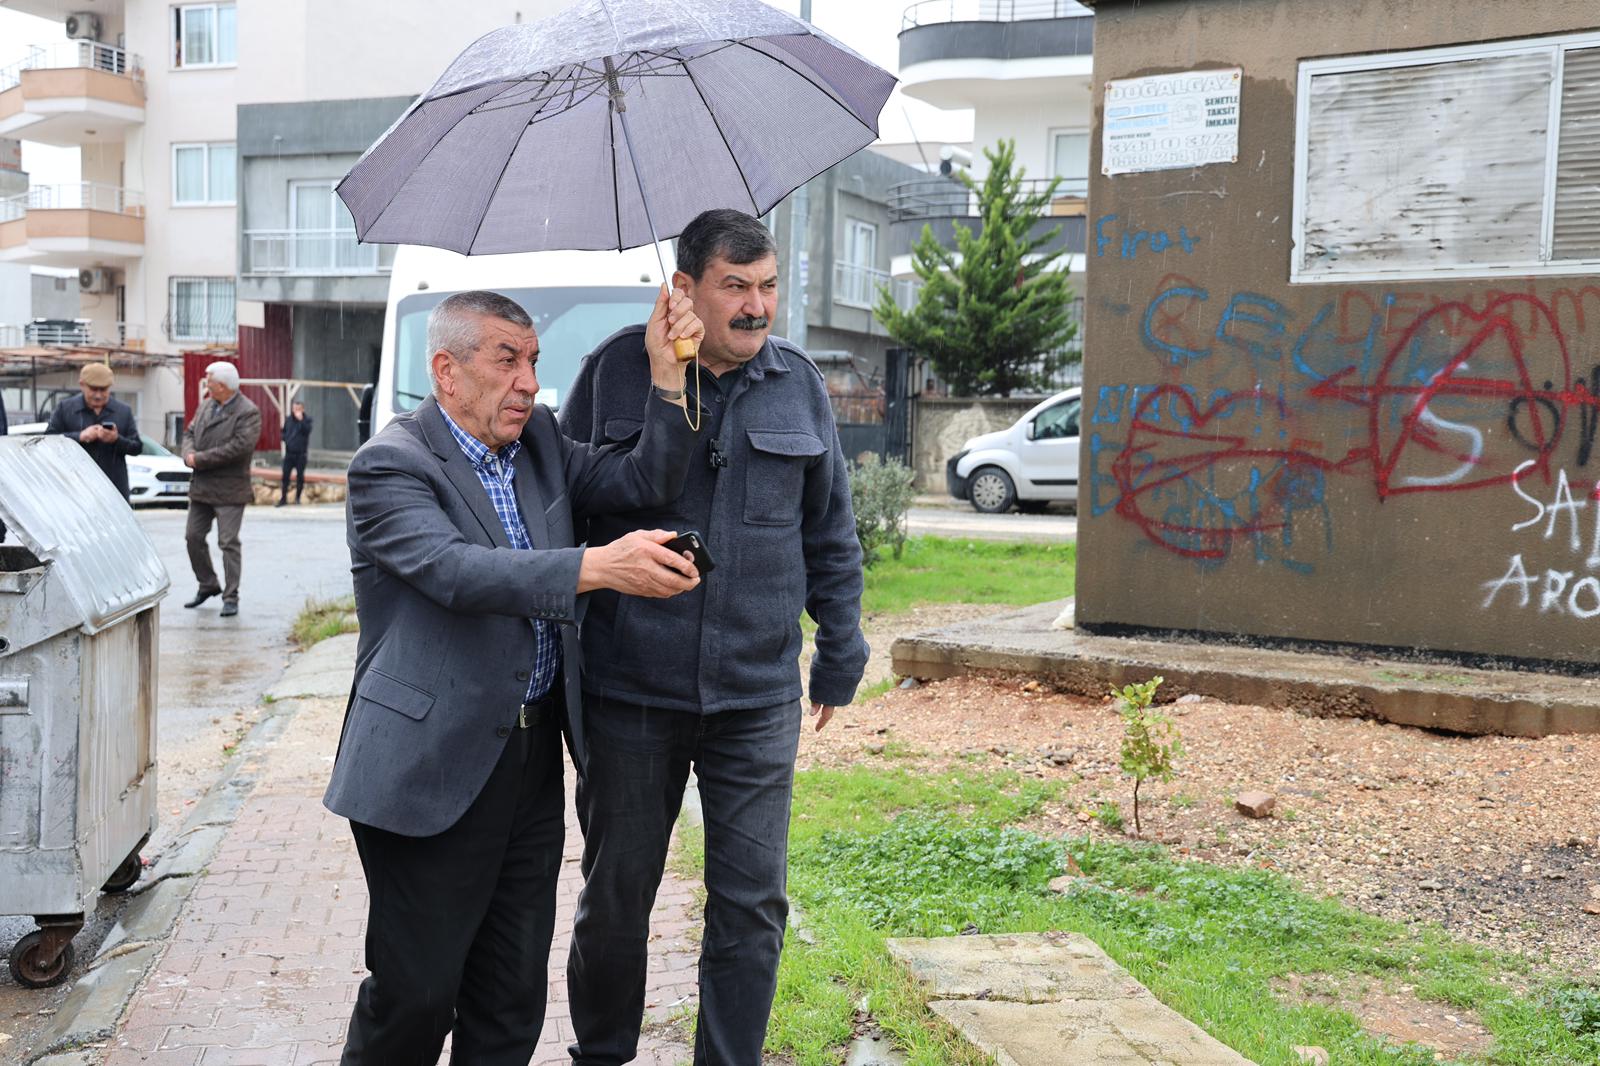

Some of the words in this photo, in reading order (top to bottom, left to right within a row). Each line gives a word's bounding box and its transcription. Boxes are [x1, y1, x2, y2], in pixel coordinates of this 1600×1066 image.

[1205, 96, 1238, 106] SENETLE
[1207, 106, 1236, 117] TAKSİT
[1206, 118, 1236, 127] İMKANI
